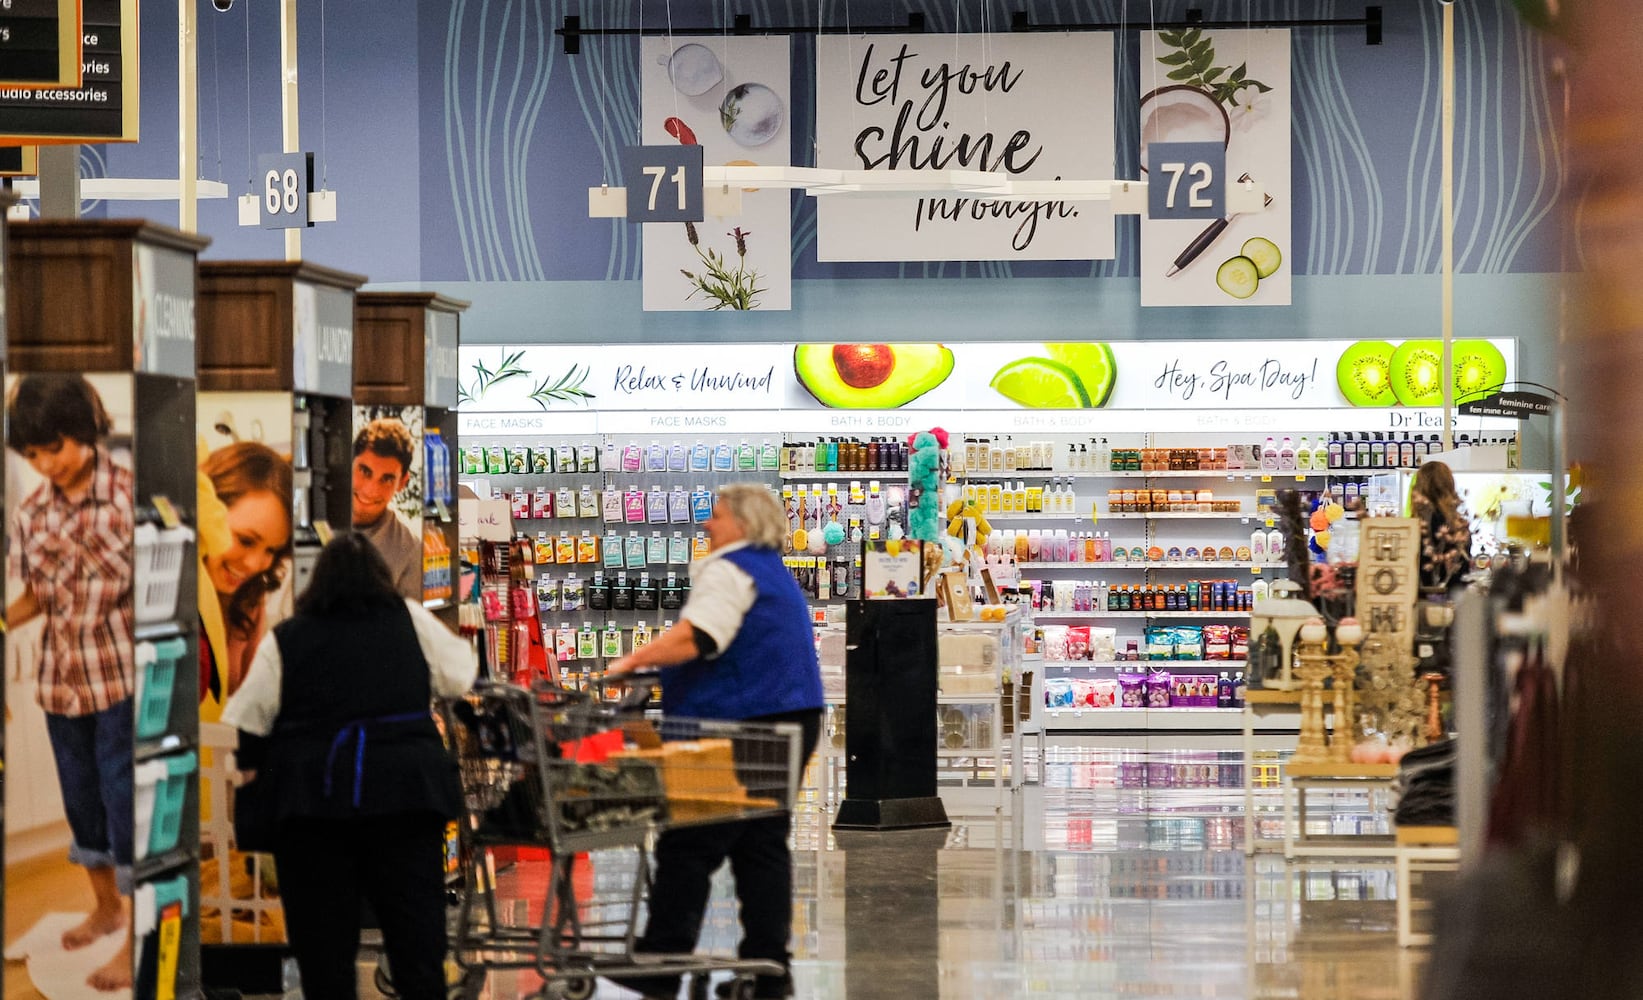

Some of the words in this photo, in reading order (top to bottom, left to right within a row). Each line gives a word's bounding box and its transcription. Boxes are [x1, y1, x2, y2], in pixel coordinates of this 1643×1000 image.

[34, 87, 108, 102] accessories
[855, 43, 919, 106] Let
[916, 61, 1024, 132] you
[854, 99, 1043, 175] shine
[265, 168, 299, 215] 68
[641, 165, 688, 212] 71
[1159, 160, 1214, 209] 72
[613, 364, 667, 395] Relax
[671, 373, 686, 393] &
[690, 366, 774, 393] Unwind
[1154, 359, 1206, 401] Hey,
[1209, 360, 1257, 400] Spa
[1259, 357, 1318, 400] Day!
[1499, 397, 1534, 410] feminine
[466, 418, 497, 429] FACE
[500, 417, 543, 429] MASKS
[650, 416, 681, 427] FACE
[684, 416, 727, 427] MASKS
[831, 416, 862, 426] BATH
[867, 416, 874, 426] &
[877, 416, 911, 426] BODY
[1013, 416, 1045, 426] BATH
[1060, 416, 1095, 426] BODY
[1389, 411, 1412, 427] Dr
[1414, 411, 1458, 427] Teas
